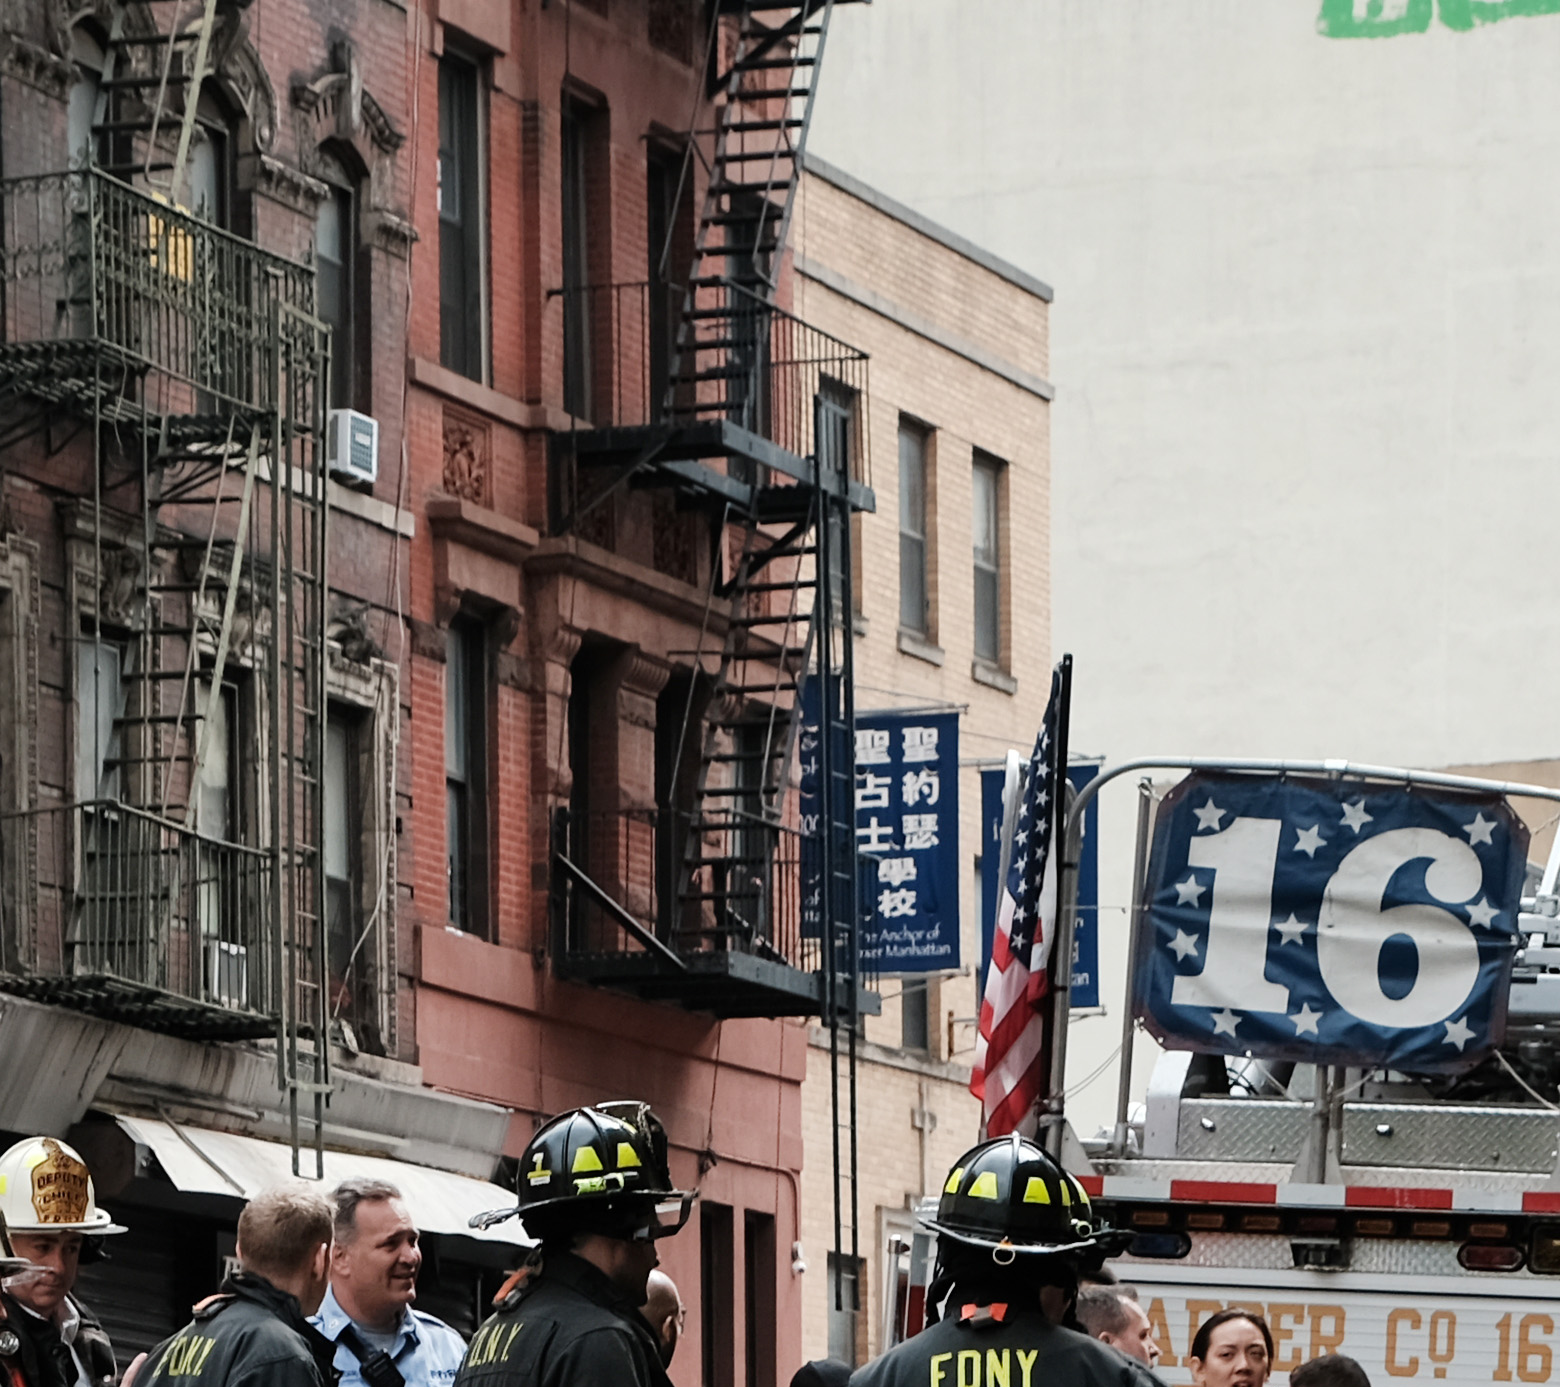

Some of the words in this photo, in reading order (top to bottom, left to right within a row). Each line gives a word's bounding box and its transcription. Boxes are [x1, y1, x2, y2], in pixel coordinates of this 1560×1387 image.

[1172, 817, 1484, 1028] 16
[879, 924, 924, 943] Anchor
[885, 943, 952, 957] Manhattan
[37, 1172, 85, 1189] DEPUTY
[1492, 1312, 1555, 1383] 16
